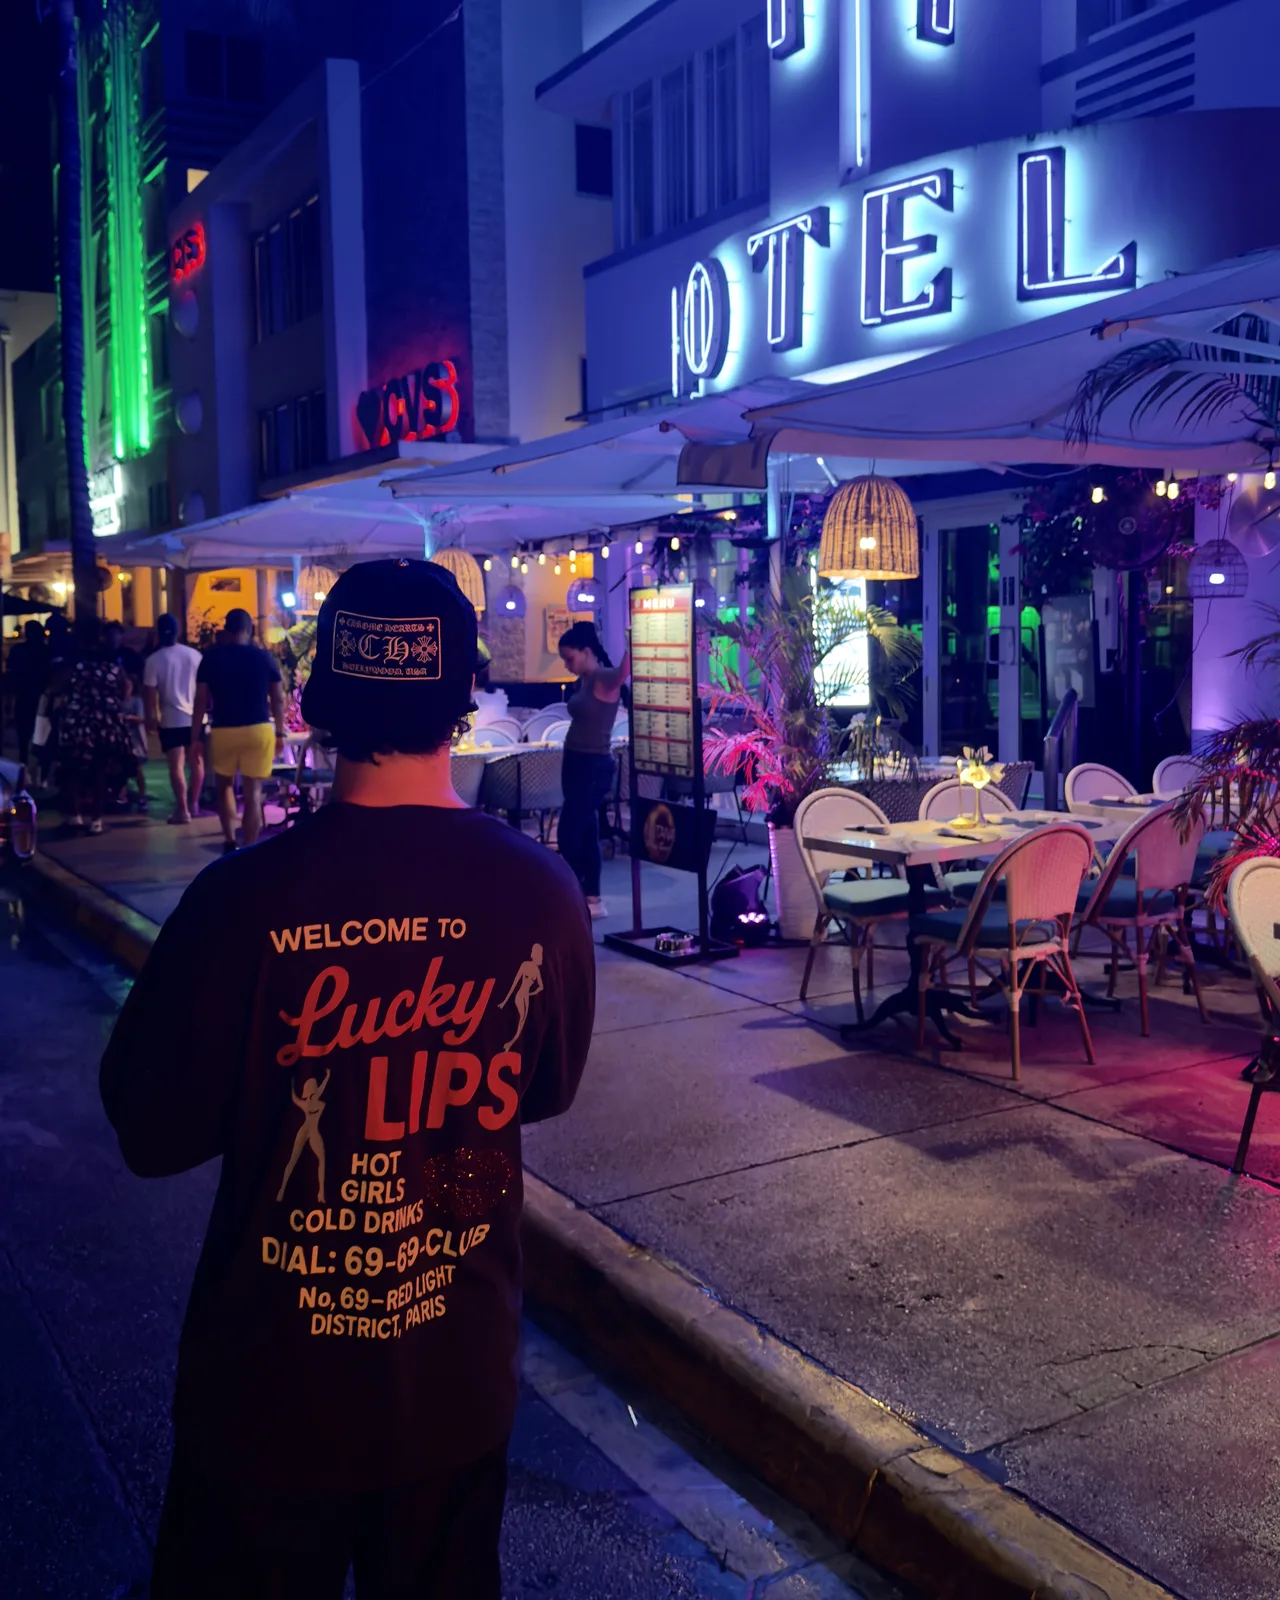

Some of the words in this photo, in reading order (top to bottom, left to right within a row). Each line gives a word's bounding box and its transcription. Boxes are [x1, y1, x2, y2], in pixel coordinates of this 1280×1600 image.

[384, 360, 459, 441] CVS
[358, 634, 409, 665] CH
[270, 917, 429, 953] WELCOME
[438, 918, 467, 939] TO
[276, 956, 496, 1066] Lucky
[364, 1050, 522, 1141] LIPS
[351, 1151, 402, 1177] HOT
[341, 1178, 406, 1204] GIRLS
[289, 1208, 356, 1233] COLD
[364, 1199, 424, 1234] DRINKS
[262, 1236, 337, 1275] DIAL:
[415, 1264, 456, 1296] LIGHT
[310, 1313, 402, 1340] DISTRICT,
[405, 1294, 446, 1331] PARIS
